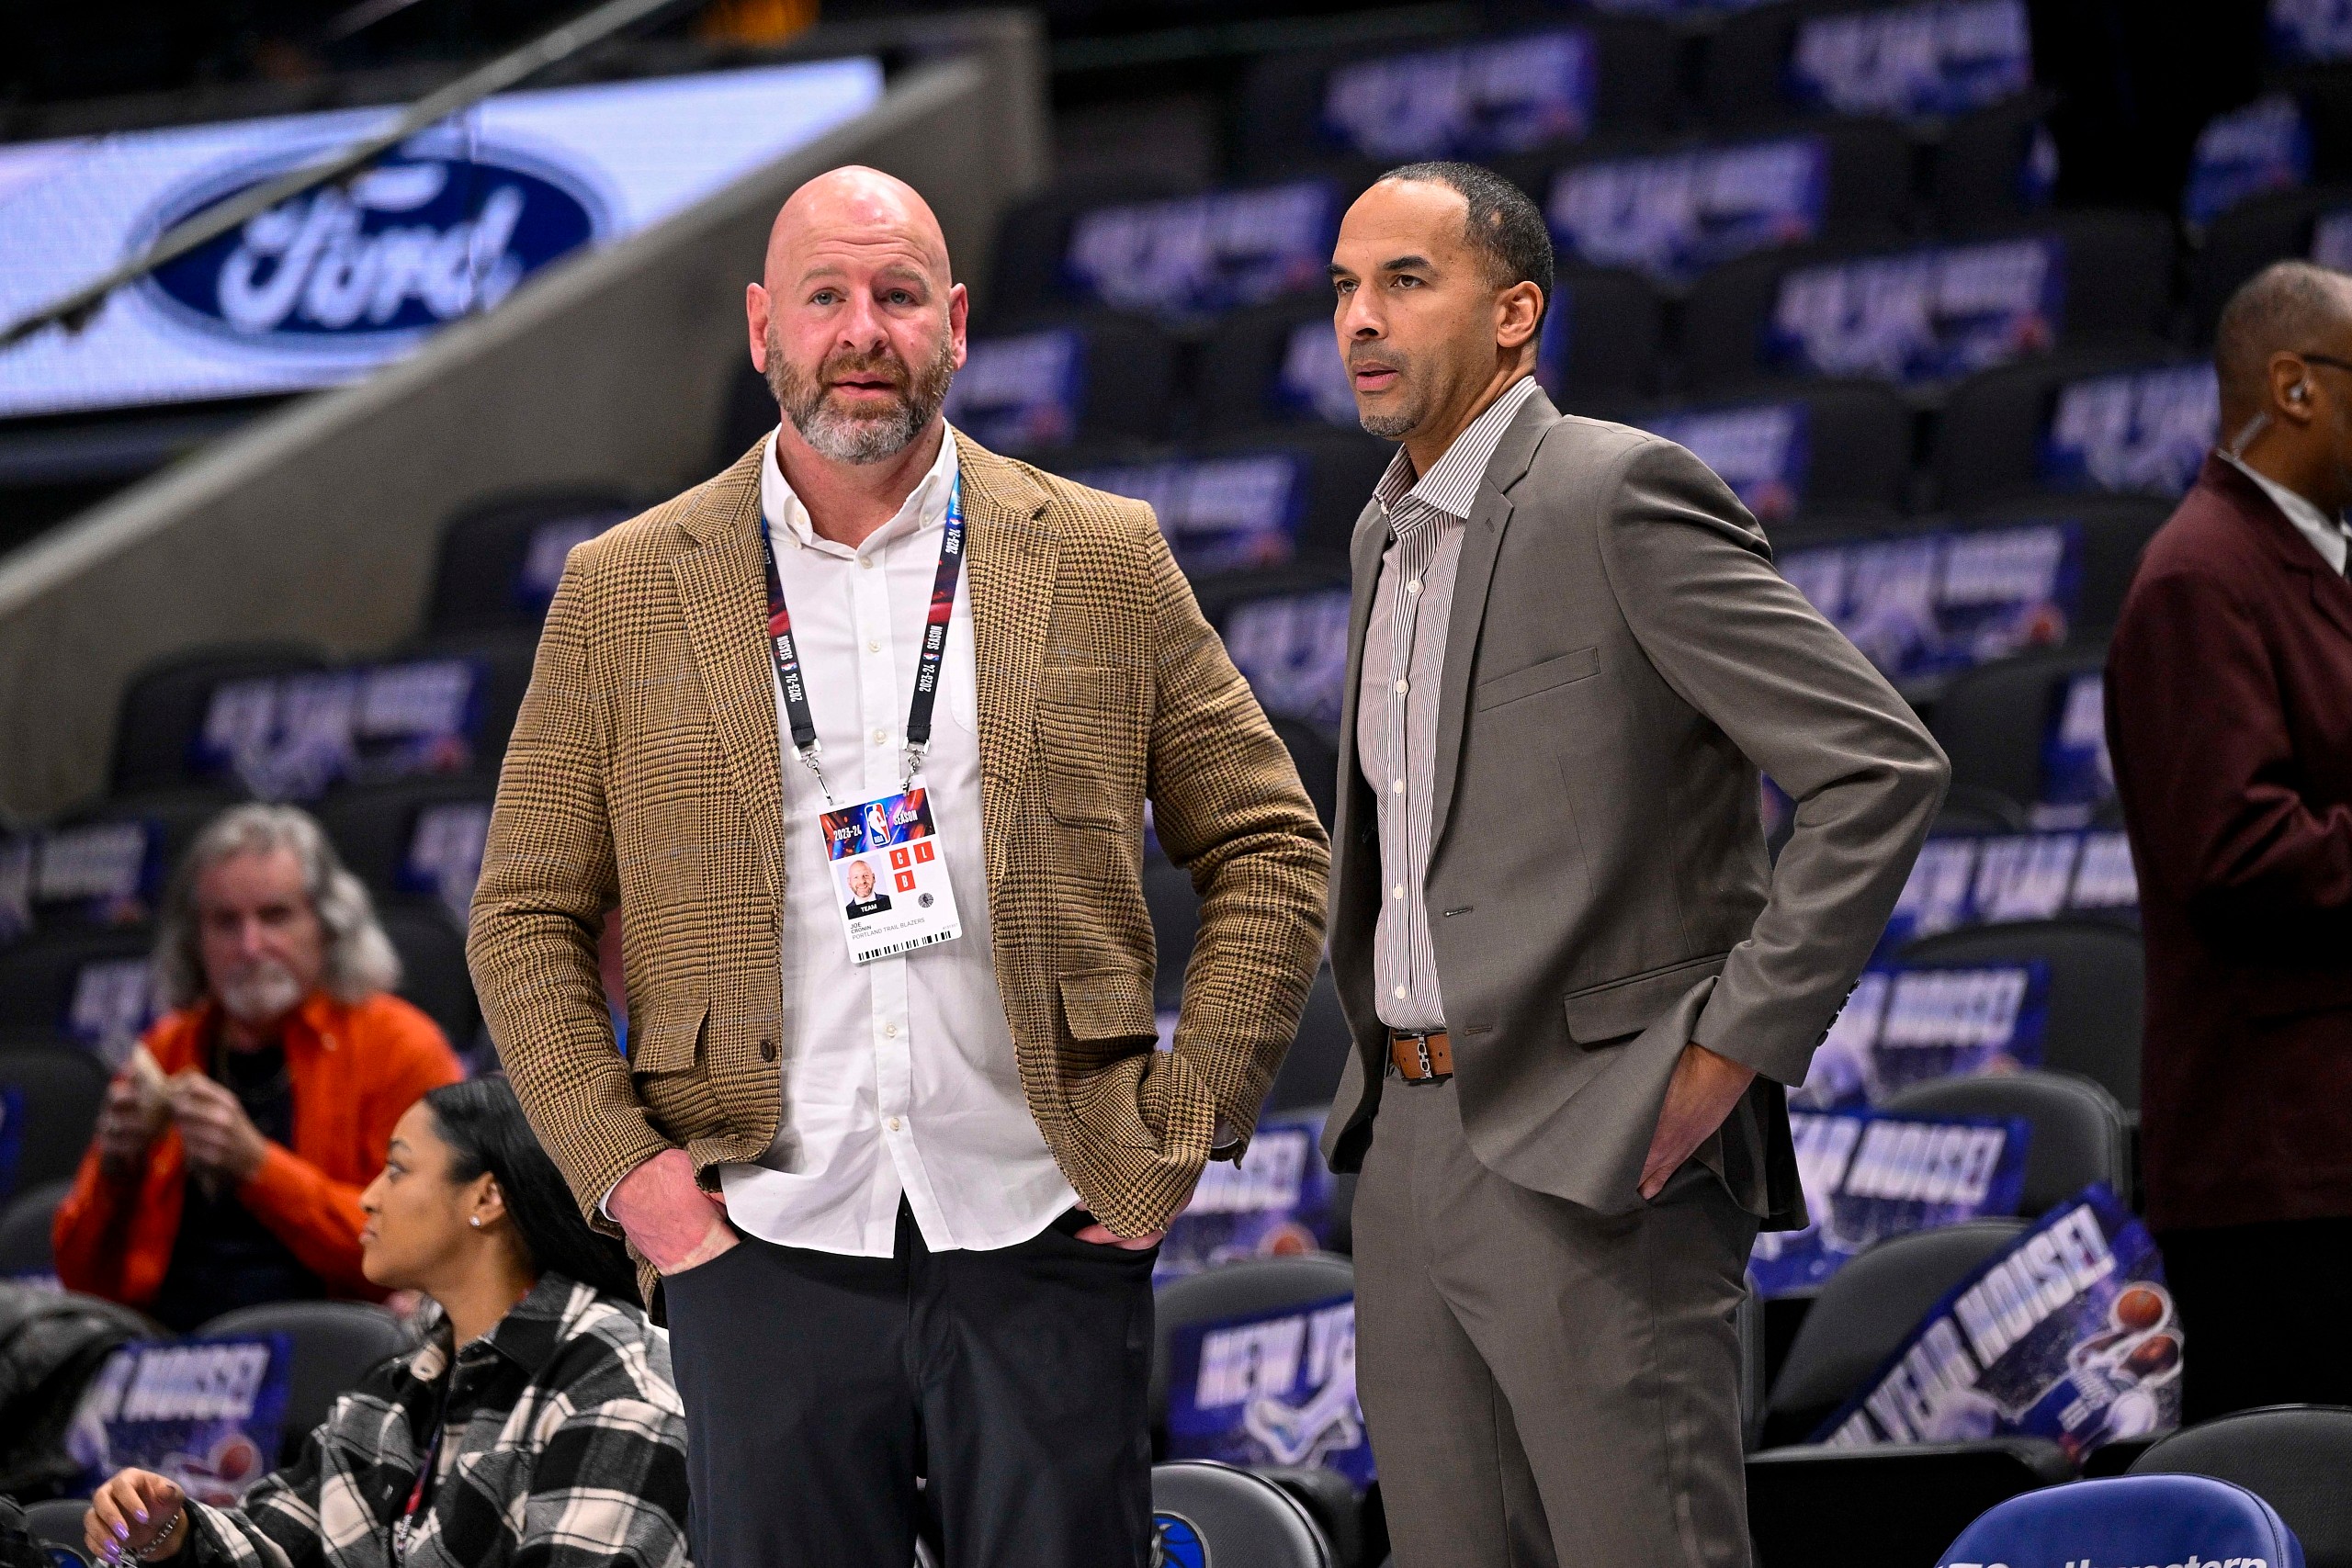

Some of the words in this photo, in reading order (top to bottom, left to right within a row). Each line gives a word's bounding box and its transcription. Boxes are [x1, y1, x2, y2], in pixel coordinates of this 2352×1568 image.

[217, 163, 524, 335] Ford
[944, 528, 961, 555] 2023-24
[776, 635, 793, 660] SEASON
[926, 625, 944, 650] SEASON
[786, 672, 803, 703] 2023-24
[919, 664, 935, 693] 2023-24
[833, 824, 862, 841] 2023-24
[893, 809, 918, 826] SEASON
[873, 835, 885, 844] NBA
[896, 852, 904, 865] C
[921, 846, 928, 859] L
[901, 874, 909, 888] B
[860, 903, 877, 913] TEAM
[850, 921, 862, 930] JOE
[851, 925, 872, 934] CRONIN
[852, 928, 883, 941] PORTLAND
[883, 924, 899, 933] TRAIL
[899, 917, 925, 929] BLAZERS
[1953, 1202, 2117, 1370] NOISE!
